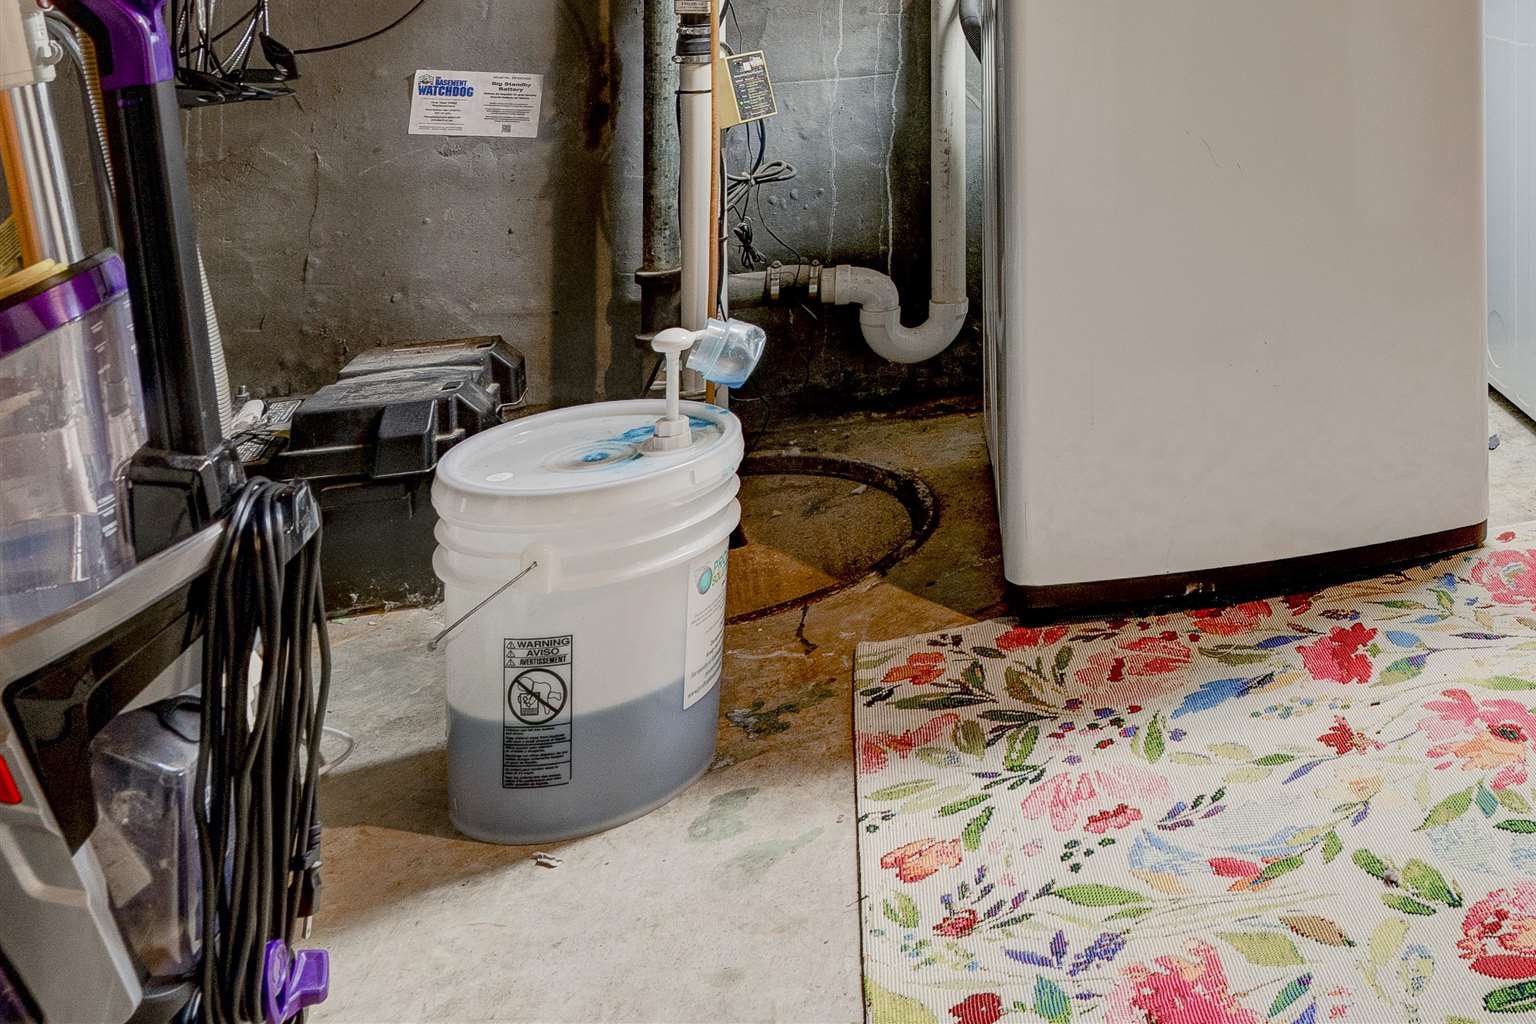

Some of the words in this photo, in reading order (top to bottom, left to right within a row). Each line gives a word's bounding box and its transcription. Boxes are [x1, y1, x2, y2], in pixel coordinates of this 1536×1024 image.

[418, 85, 474, 97] WATCHDOG
[517, 638, 570, 649] WARNING
[526, 647, 560, 657] AVISO
[519, 655, 567, 666] AVERTISSEMENT
